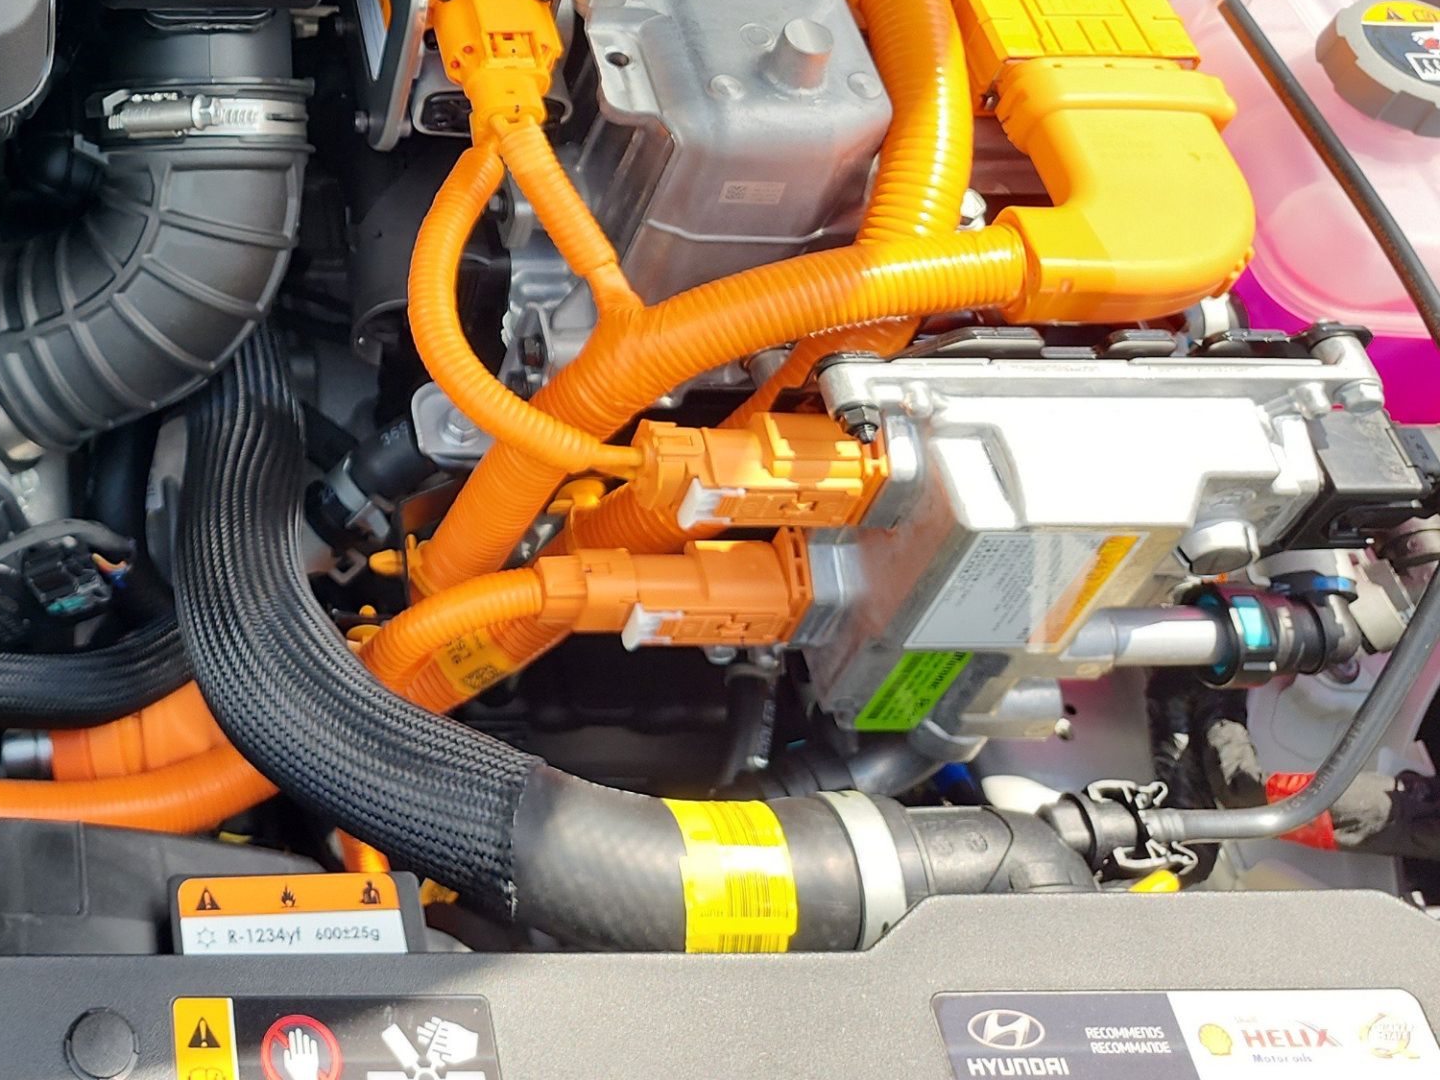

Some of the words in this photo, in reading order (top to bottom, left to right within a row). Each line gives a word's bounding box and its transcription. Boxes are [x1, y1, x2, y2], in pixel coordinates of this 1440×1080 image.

[228, 927, 301, 946] R-1234yf
[315, 926, 380, 942] 600±25g
[1084, 1025, 1165, 1039] RECOMMENDS
[1241, 1027, 1339, 1048] HELIX
[1090, 1040, 1172, 1054] RECOMMANDE
[966, 1056, 1070, 1076] HYUNDAI
